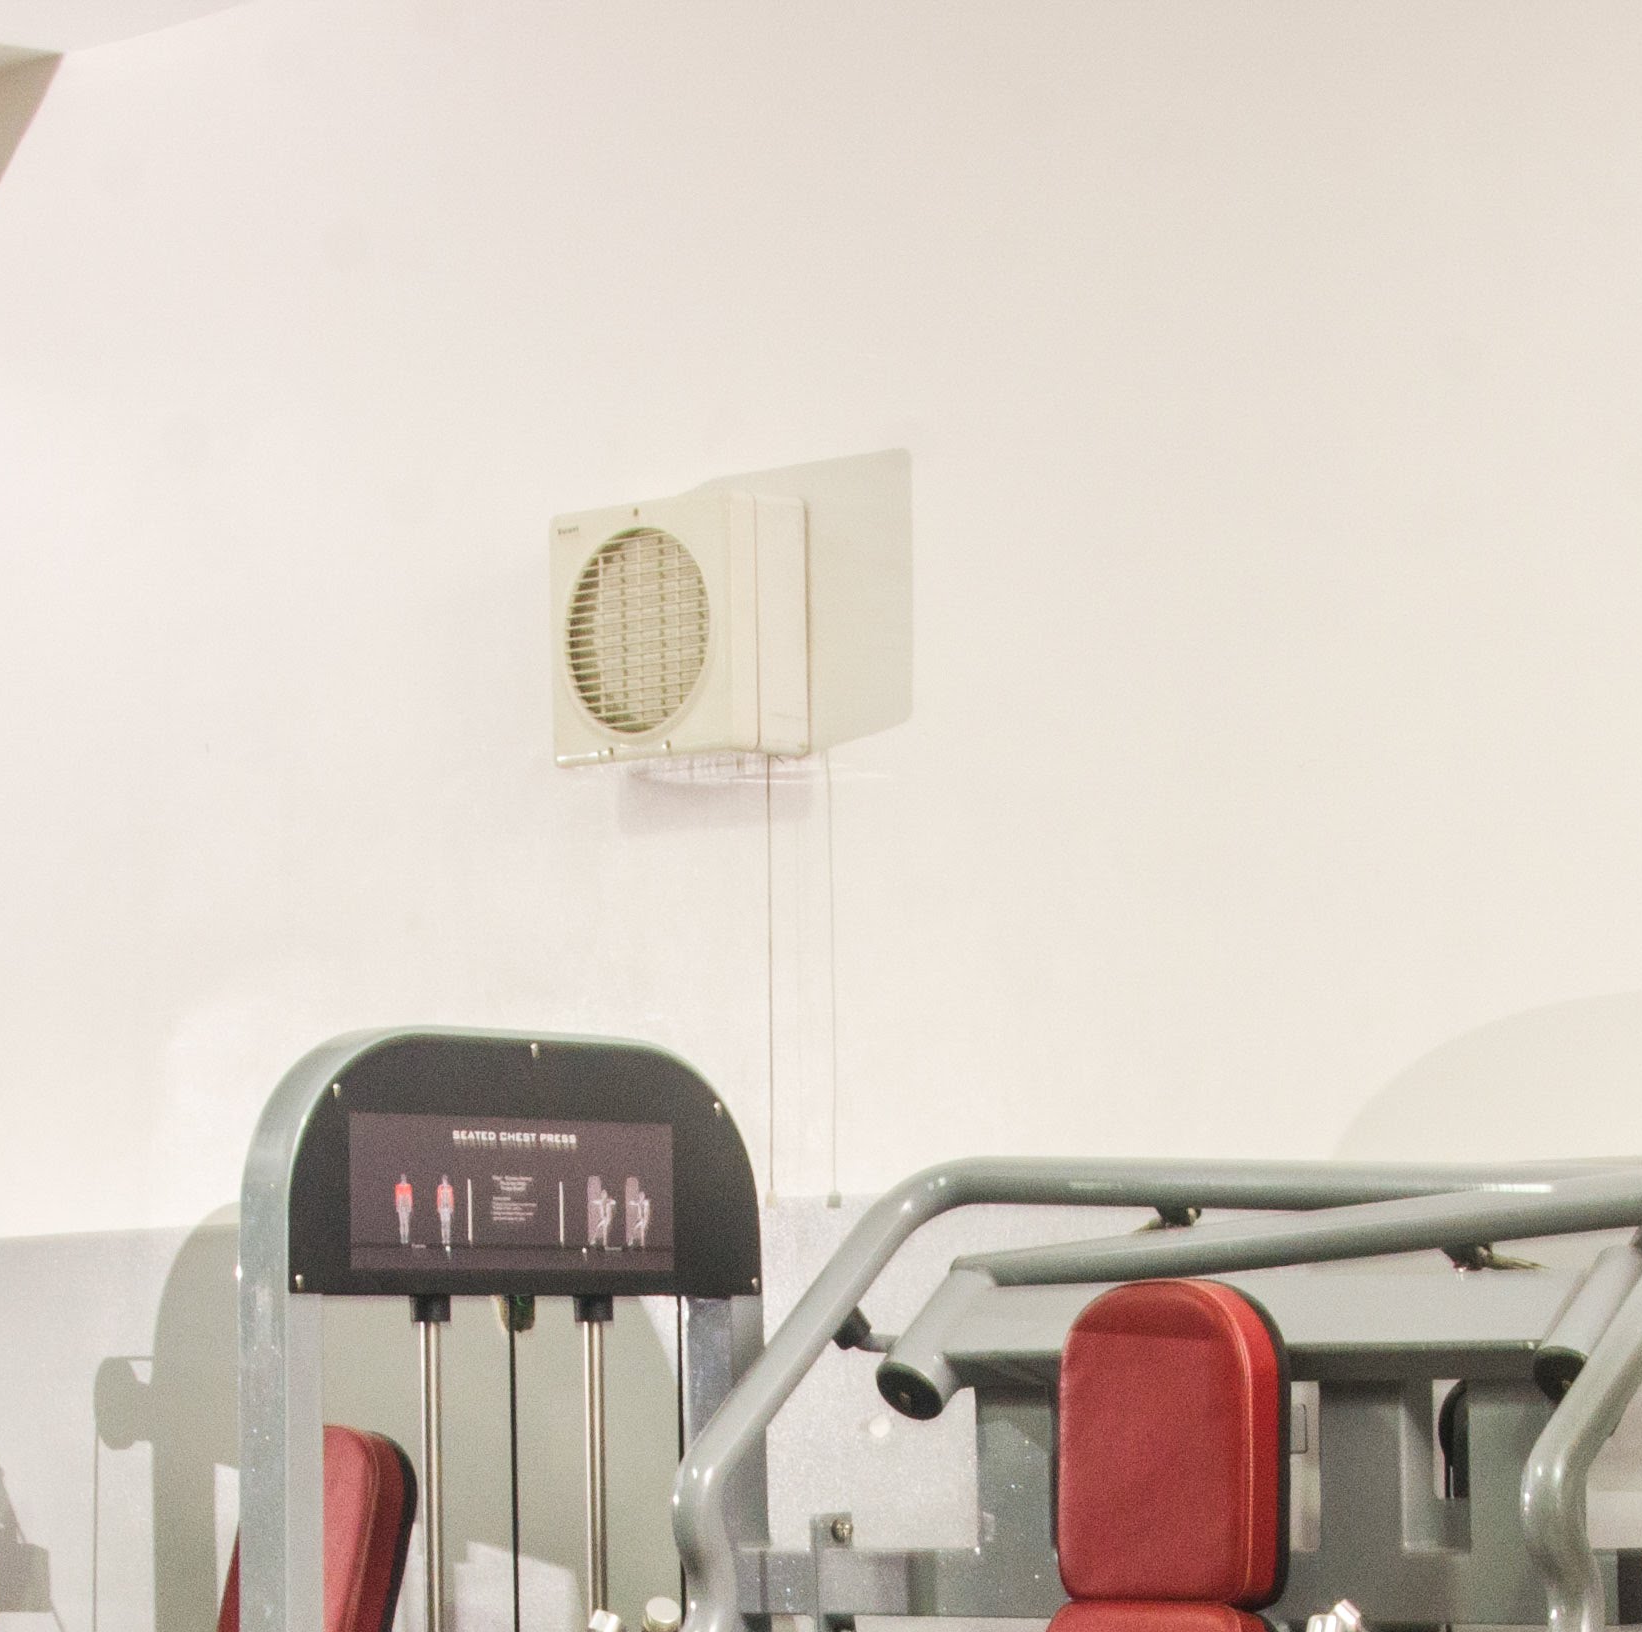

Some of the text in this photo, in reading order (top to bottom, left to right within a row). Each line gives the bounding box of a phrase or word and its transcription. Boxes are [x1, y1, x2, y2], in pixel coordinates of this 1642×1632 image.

[452, 1130, 577, 1145] SEATED CHEST PRESS
